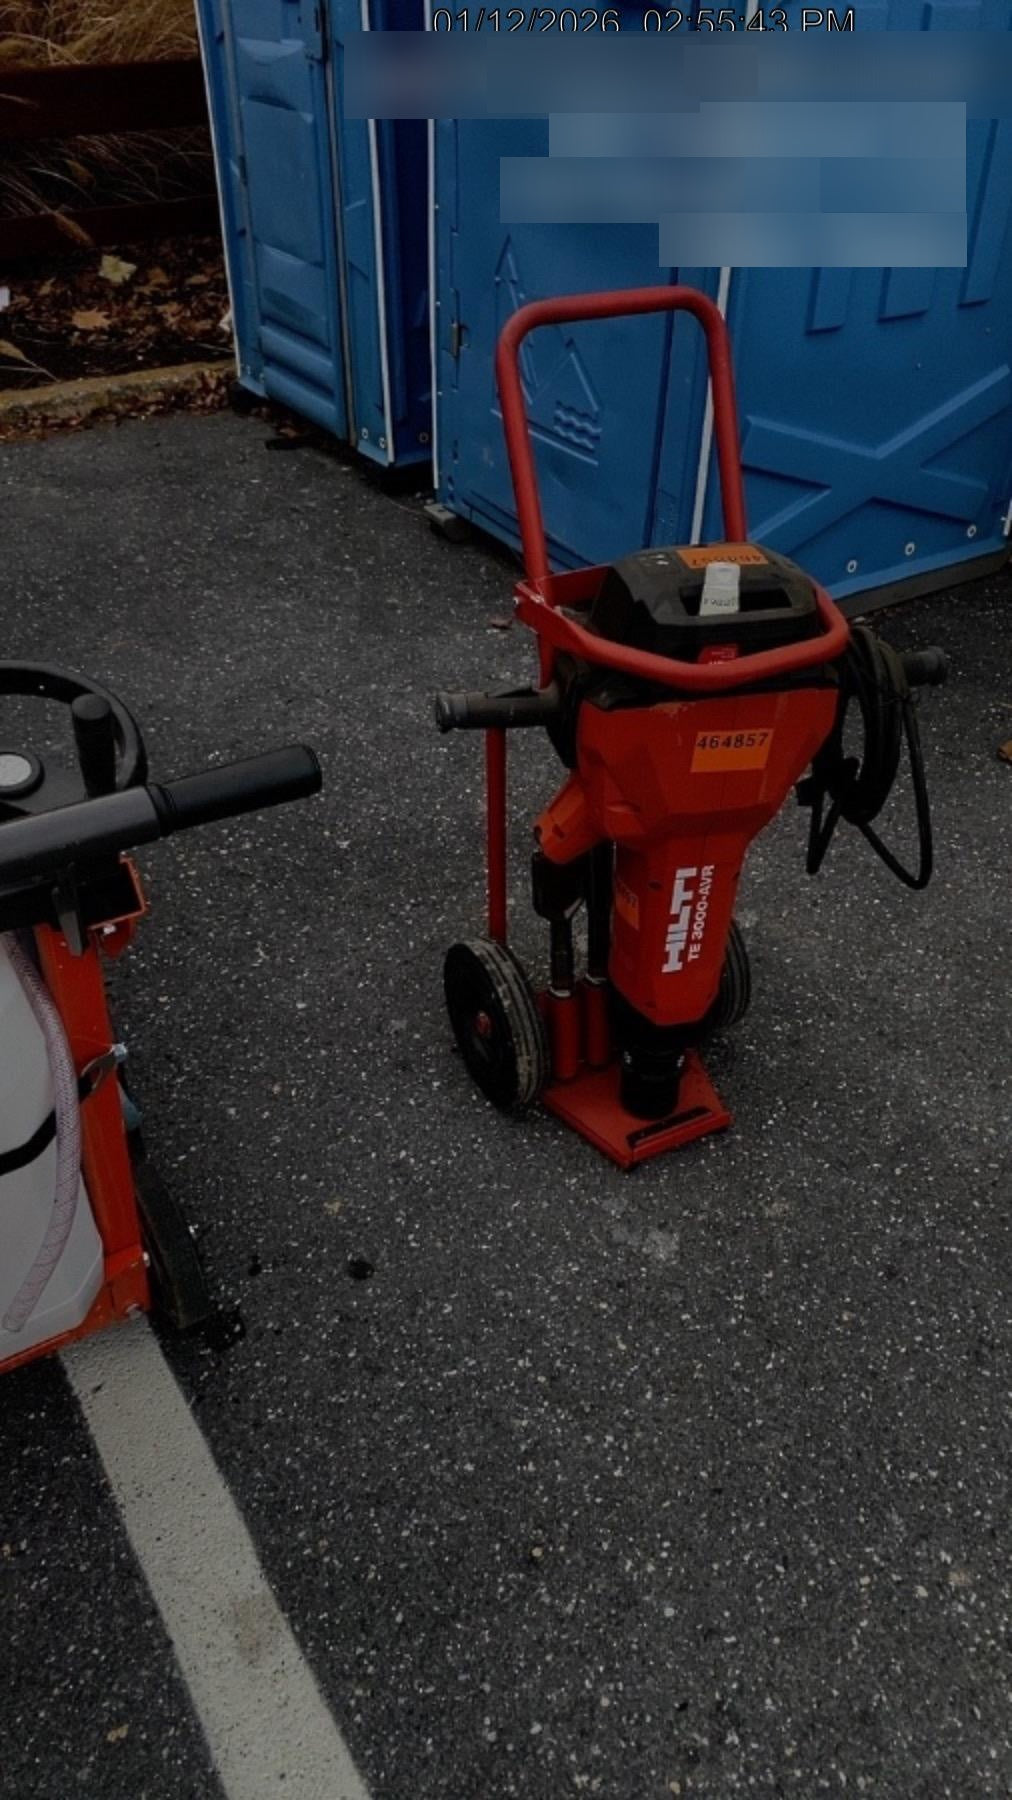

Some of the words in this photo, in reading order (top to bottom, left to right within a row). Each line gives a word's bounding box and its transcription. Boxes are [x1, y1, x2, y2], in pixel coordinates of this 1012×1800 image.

[697, 732, 769, 750] 464857
[661, 867, 698, 973] HILTI
[691, 864, 715, 940] 3000-AVR
[687, 943, 702, 962] TE
